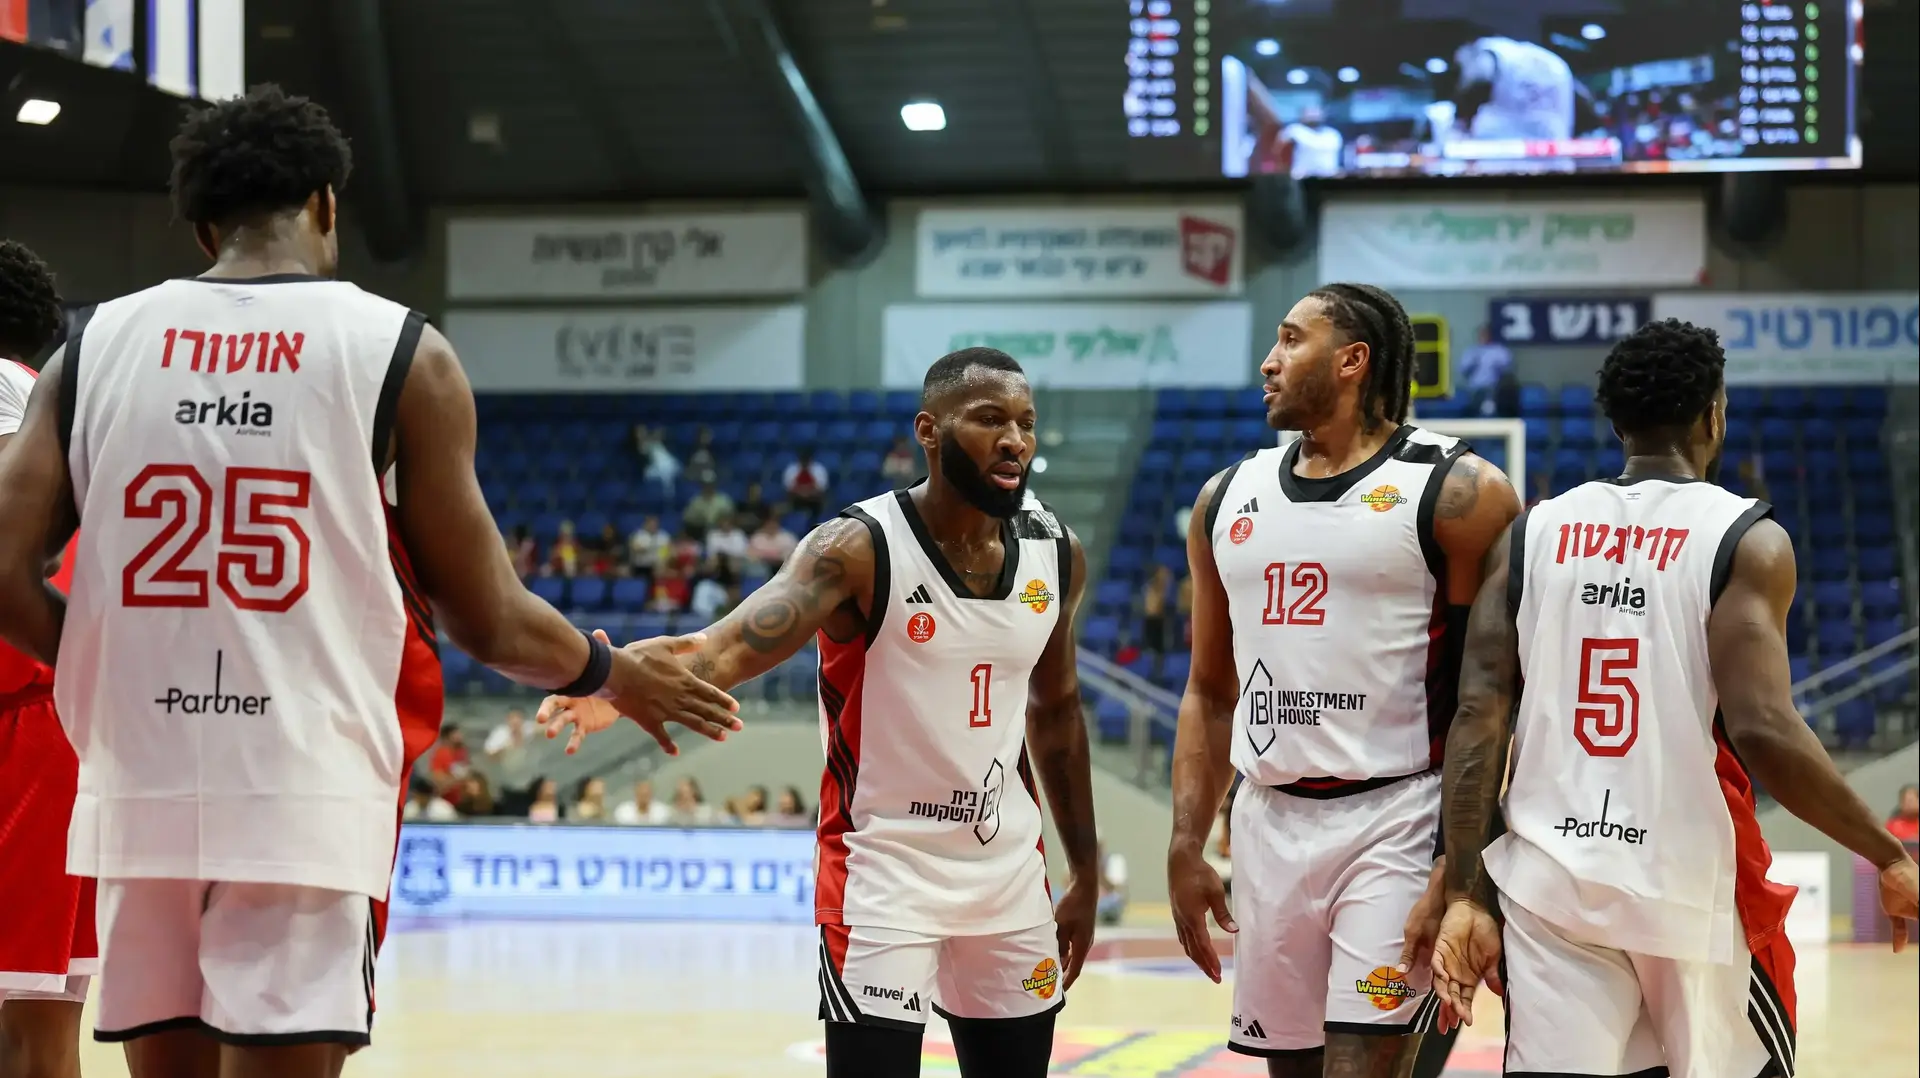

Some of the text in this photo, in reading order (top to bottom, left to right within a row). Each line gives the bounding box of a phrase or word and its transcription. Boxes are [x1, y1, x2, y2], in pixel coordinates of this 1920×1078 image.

[1500, 302, 1638, 341] גוש ב
[161, 328, 305, 374] אוטורו
[175, 390, 273, 427] arkia
[235, 427, 272, 437] Airlines
[1360, 493, 1397, 503] Winner
[122, 463, 311, 613] 25
[1555, 522, 1690, 572] קריגטון
[1019, 592, 1049, 603] Winner
[1262, 562, 1328, 626] 12
[1581, 577, 1646, 609] arkia
[1618, 606, 1646, 617] Airlines
[155, 649, 271, 716] Partner
[969, 663, 993, 728] 1
[1277, 690, 1367, 711] INVESTMENT
[1573, 637, 1640, 758] 5
[1277, 708, 1321, 726] HOUSE
[950, 789, 978, 807] בית
[908, 801, 976, 824] השקעות
[1554, 789, 1648, 845] Partner
[462, 853, 562, 891] ביחד
[575, 855, 734, 892] בספורט
[863, 984, 904, 1001] nuvei
[1022, 973, 1057, 991] Winner
[1356, 980, 1405, 996] Winner
[1388, 980, 1405, 989] ליגת
[1405, 986, 1416, 997] סל
